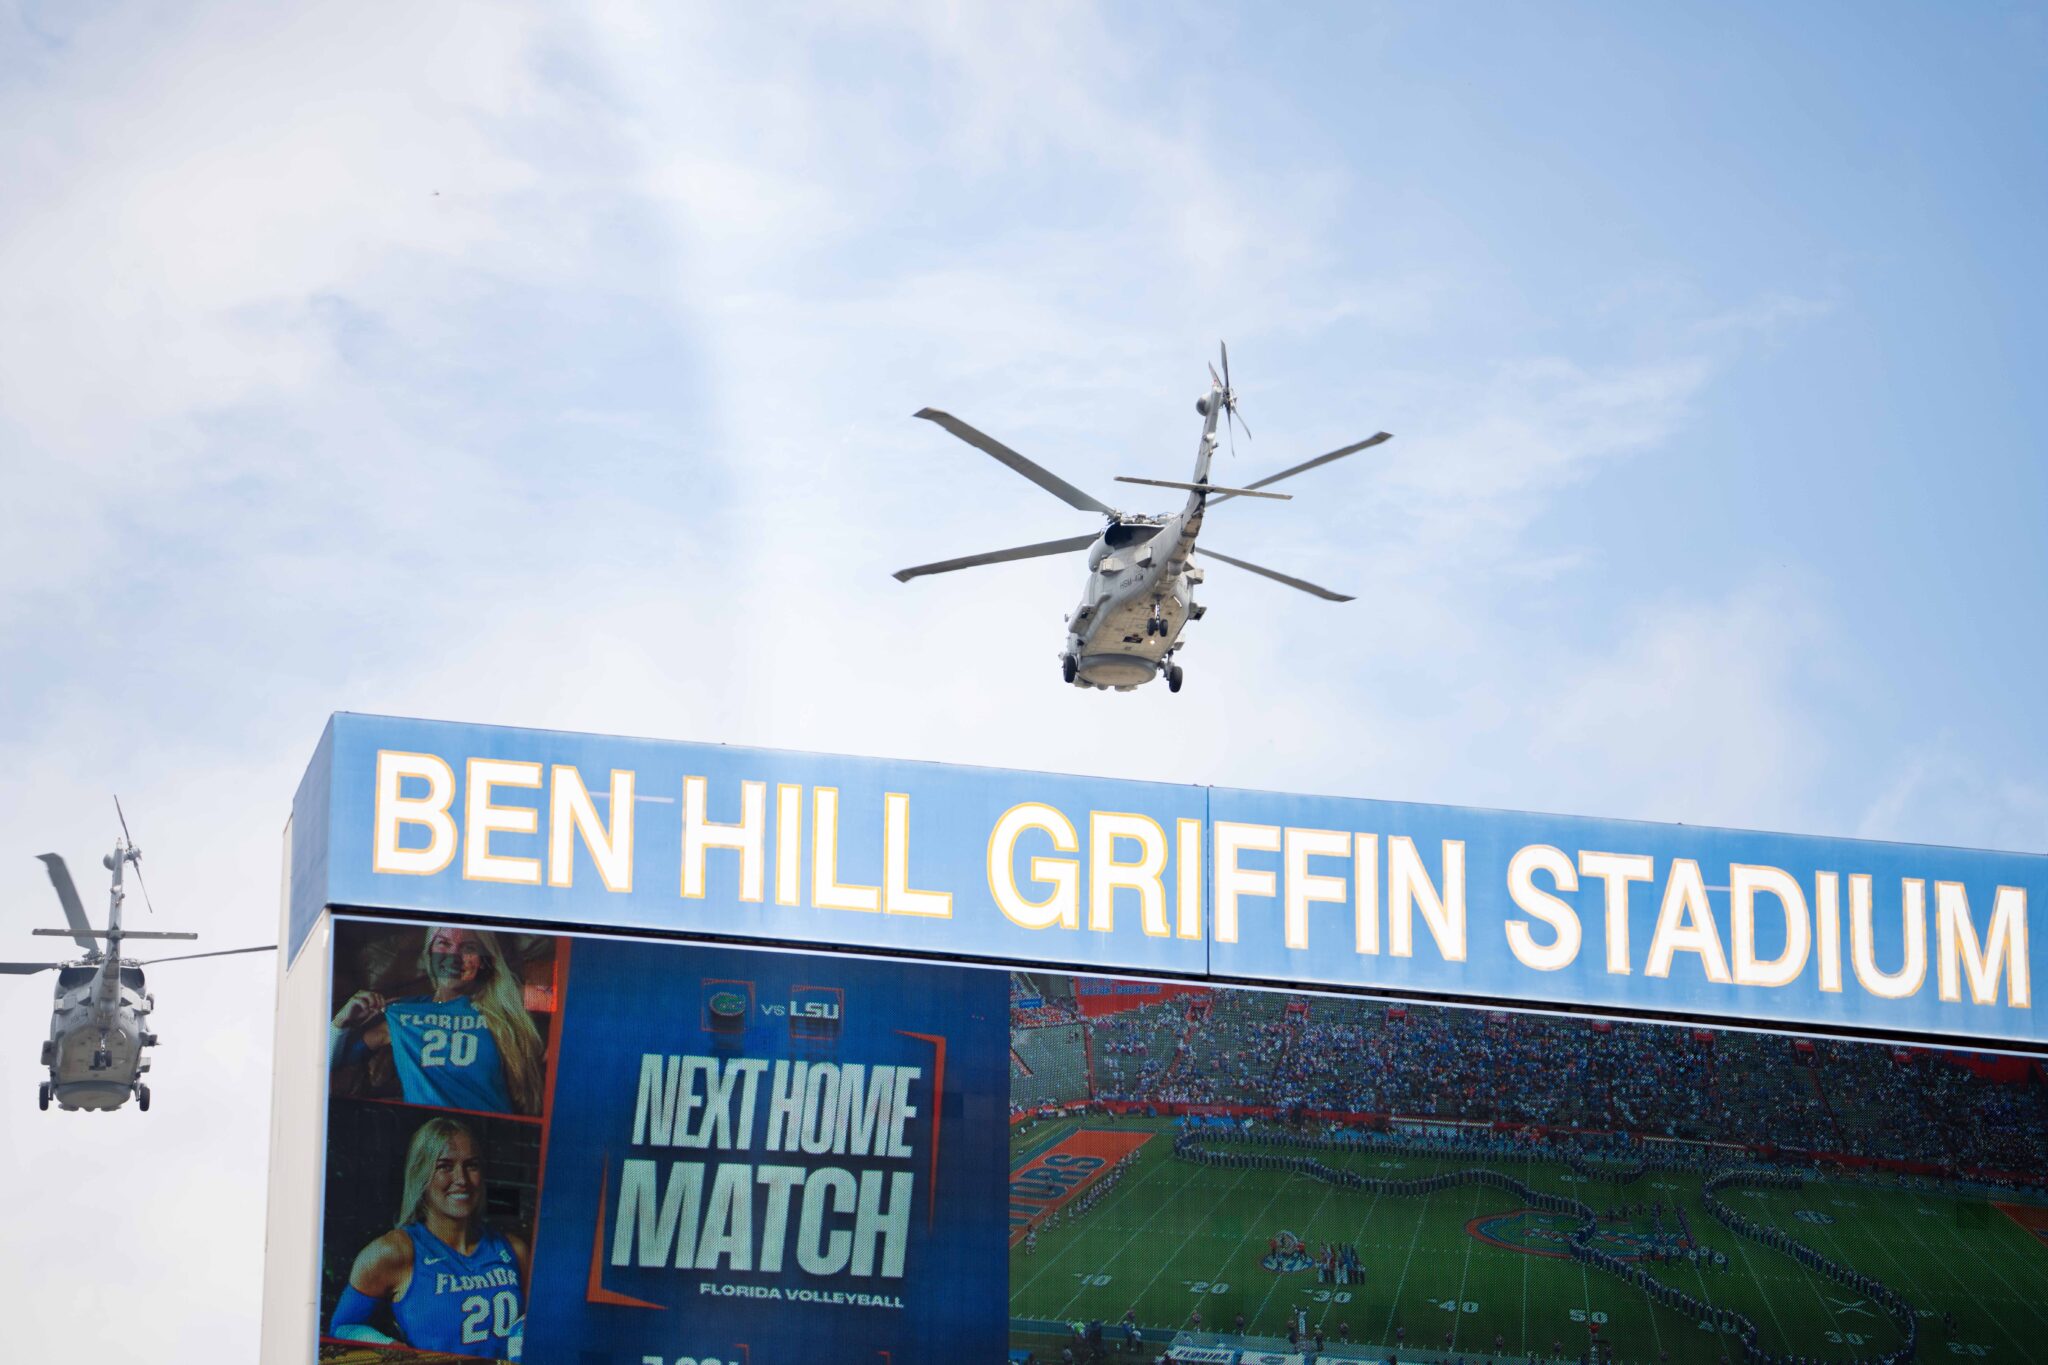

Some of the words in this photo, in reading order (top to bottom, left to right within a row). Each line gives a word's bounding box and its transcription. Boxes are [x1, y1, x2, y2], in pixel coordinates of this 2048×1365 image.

[372, 749, 635, 892] BEN
[680, 775, 953, 919] HILL
[985, 802, 1468, 962] GRIFFIN
[1505, 844, 2032, 1010] STADIUM
[400, 1004, 488, 1030] FLORIDA
[761, 1003, 785, 1016] VS
[790, 1000, 839, 1020] LSU
[421, 1029, 478, 1067] 20
[632, 1053, 768, 1150] NEXT
[766, 1060, 921, 1157] HOME
[610, 1159, 914, 1278] MATCH
[435, 1267, 518, 1295] FLORIDA
[1190, 1281, 1230, 1294] 20
[700, 1283, 782, 1300] FLORIDA
[785, 1287, 904, 1308] VOLLEYBALL
[1438, 1301, 1479, 1313] 40
[462, 1291, 519, 1344] 20
[1569, 1309, 1608, 1324] 50
